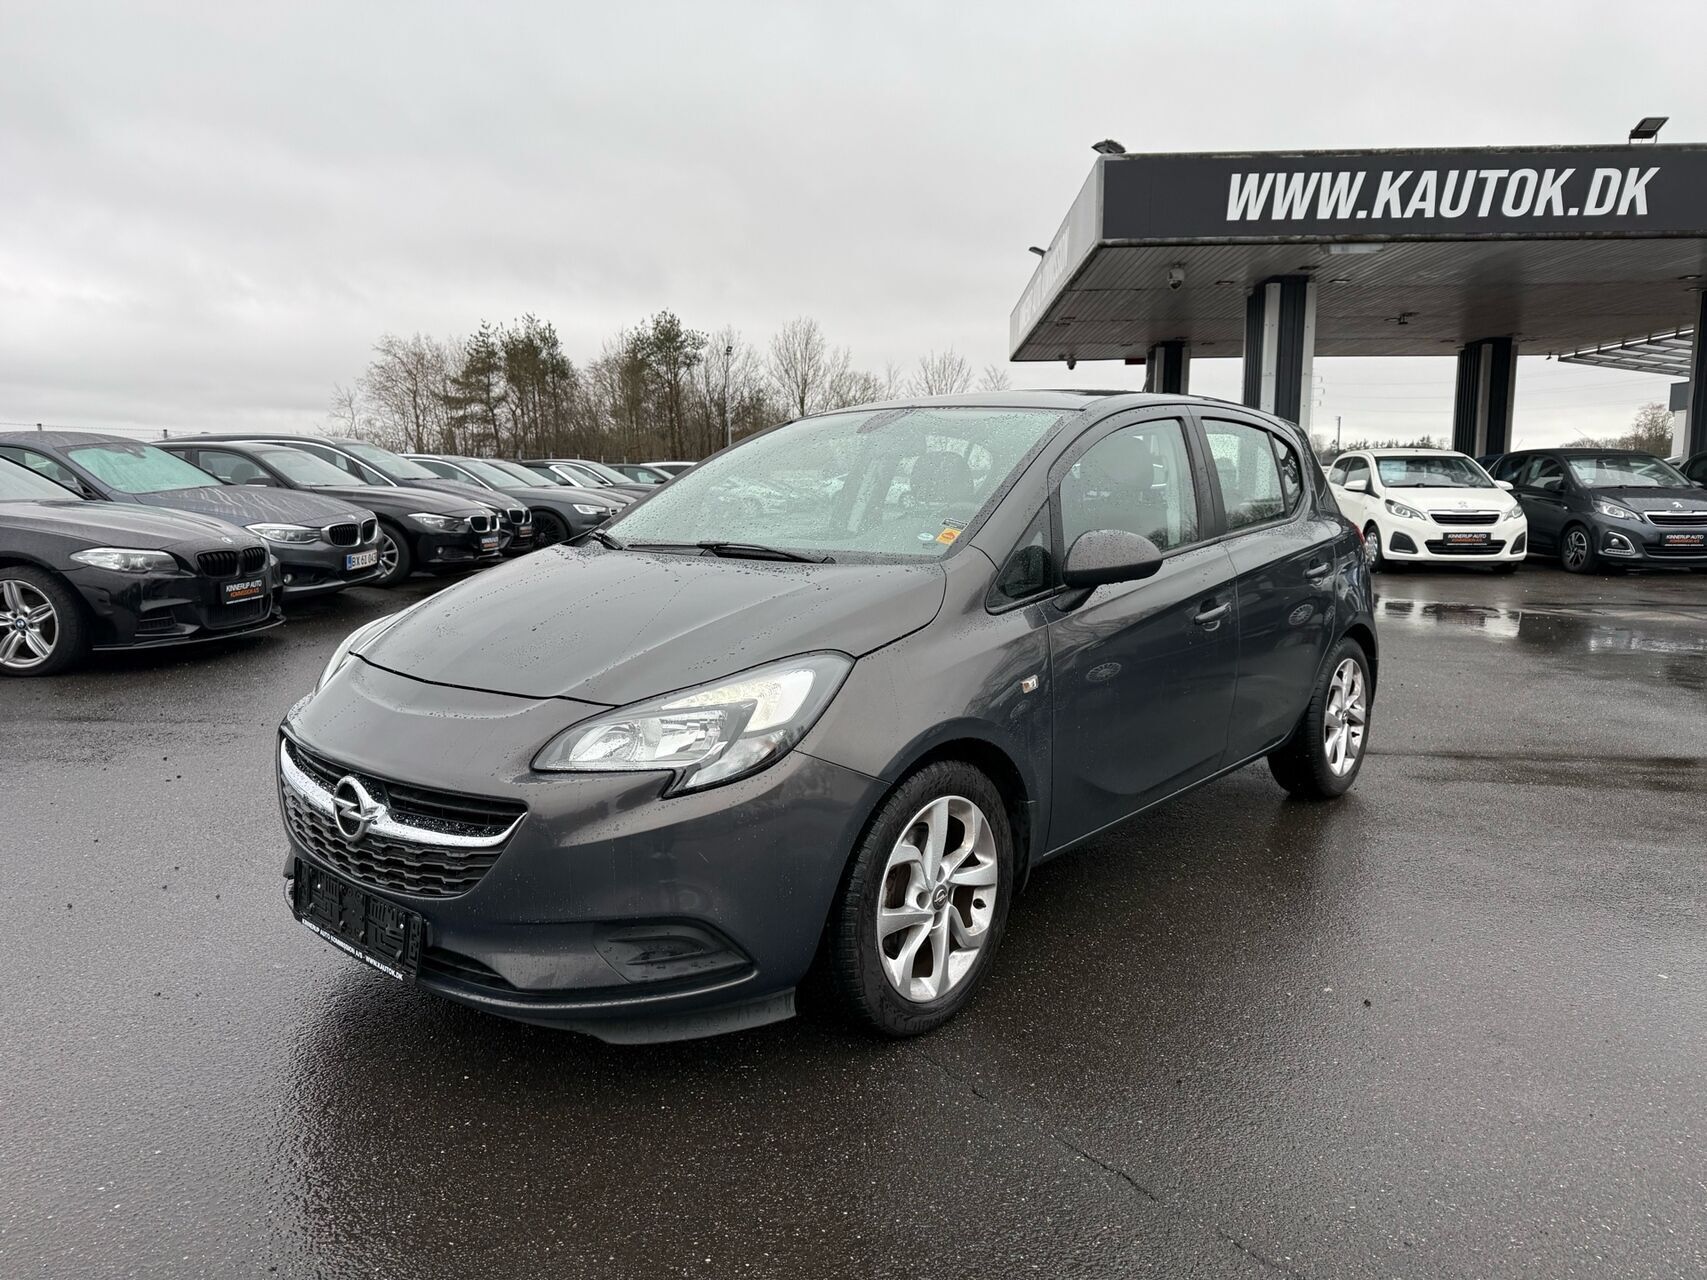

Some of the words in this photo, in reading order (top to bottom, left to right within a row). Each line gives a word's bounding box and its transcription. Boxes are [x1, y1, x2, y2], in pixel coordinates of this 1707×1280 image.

[1225, 167, 1661, 221] WWW.KAUTOK.DK
[226, 582, 250, 592] KINNERUP
[250, 580, 262, 588] AUTO
